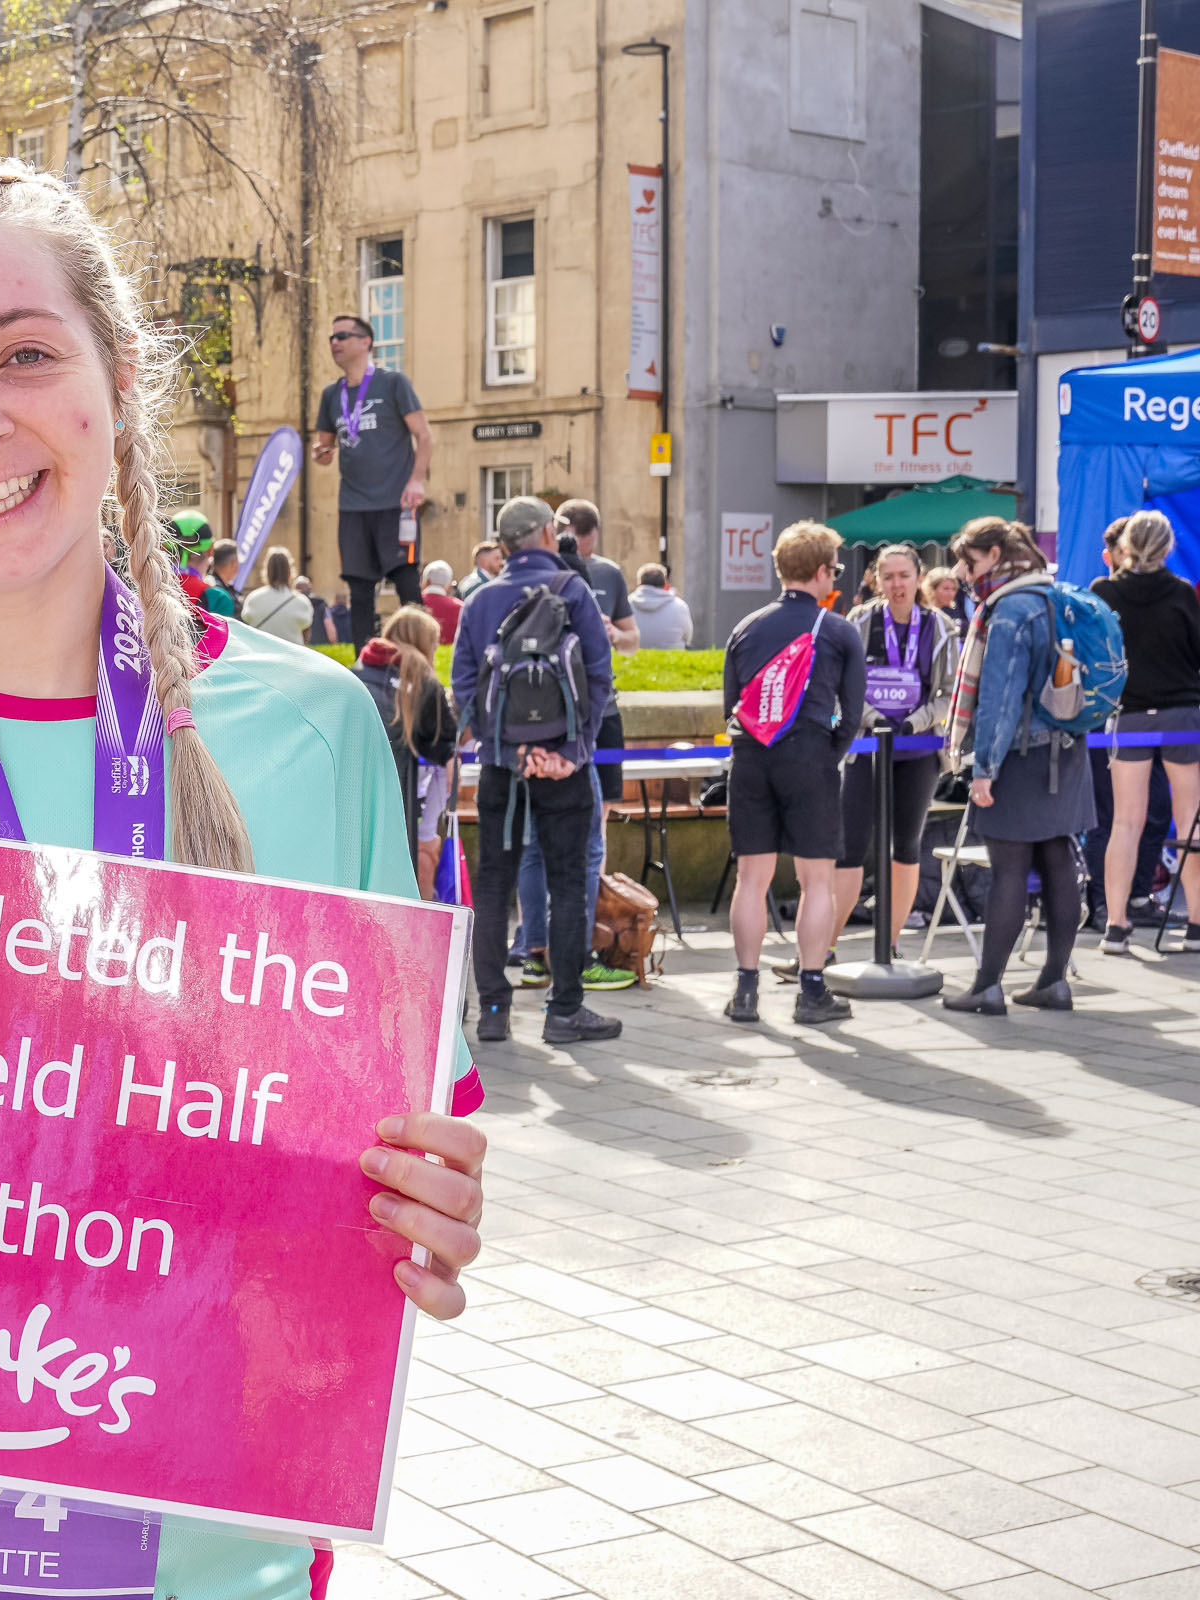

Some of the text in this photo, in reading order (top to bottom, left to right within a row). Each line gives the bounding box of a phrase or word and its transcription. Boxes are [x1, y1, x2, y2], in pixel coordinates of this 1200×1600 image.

[1158, 138, 1200, 160] Sheffield
[1158, 160, 1193, 184] is every
[1157, 181, 1189, 200] dream
[1157, 225, 1177, 240] ever
[1142, 310, 1157, 329] 20
[506, 423, 533, 437] STREET
[874, 413, 973, 456] TFC
[874, 461, 973, 473] the fitness club
[237, 450, 294, 564] URINALS
[725, 528, 765, 558] TFC
[113, 593, 143, 676] 2022
[873, 688, 907, 700] 6100
[110, 757, 122, 794] Sheffield
[131, 823, 145, 857] HON
[219, 932, 349, 1017] the
[115, 1054, 289, 1146] Half
